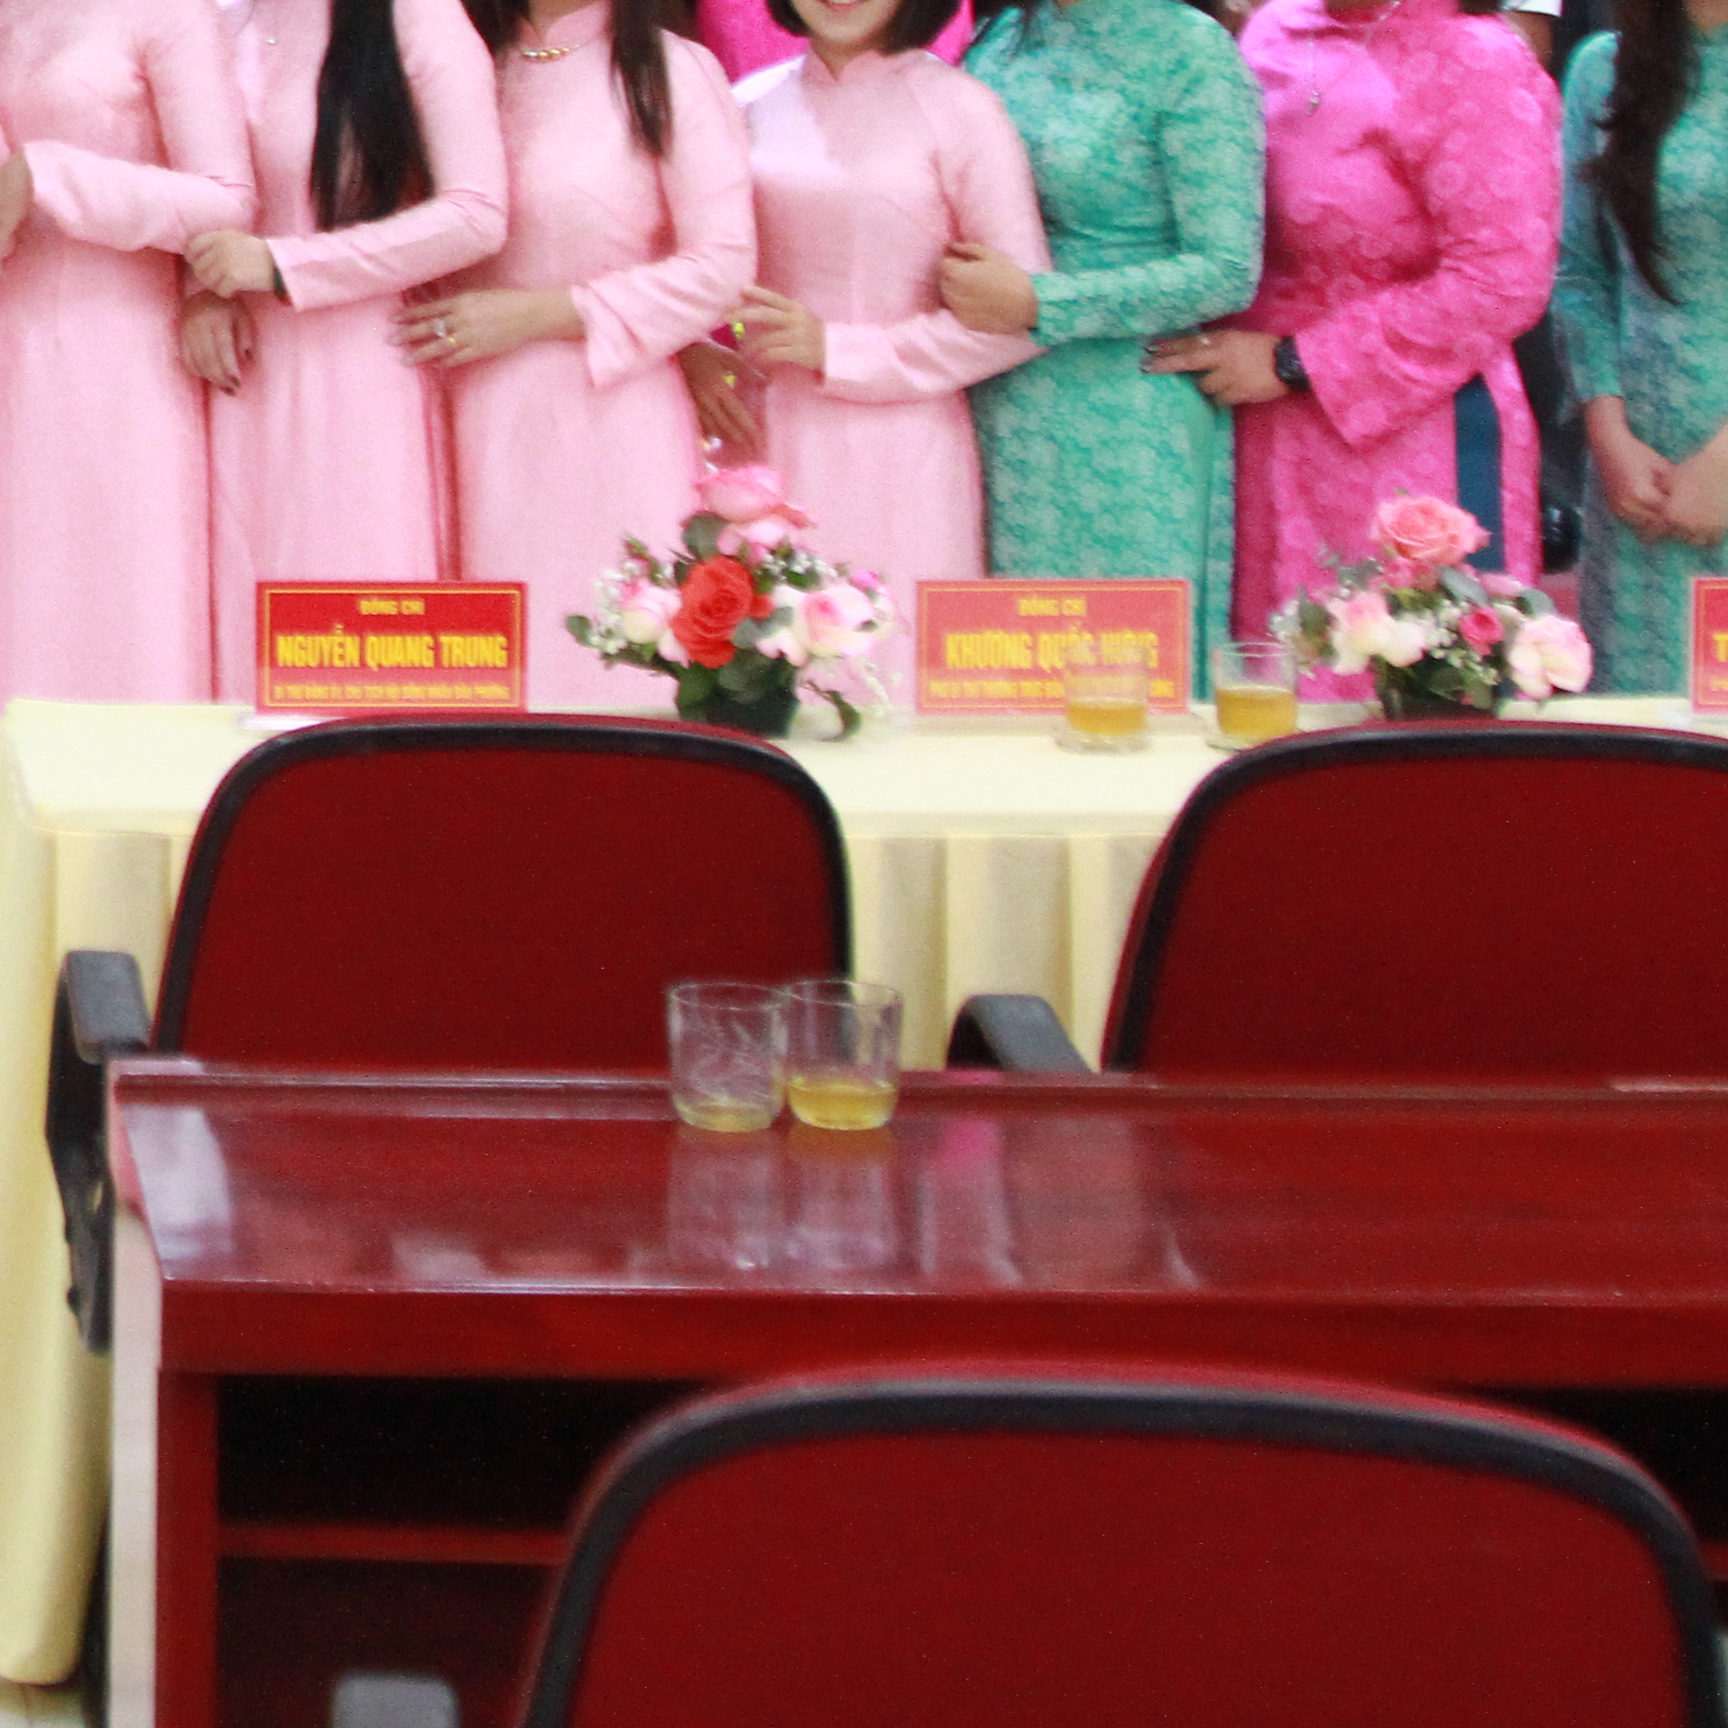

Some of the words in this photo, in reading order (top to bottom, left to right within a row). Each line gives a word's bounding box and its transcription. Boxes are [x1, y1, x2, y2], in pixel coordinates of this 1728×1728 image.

[276, 624, 361, 668] NGUYỄN
[366, 634, 435, 671] QUANG
[438, 634, 509, 668] TRUNG
